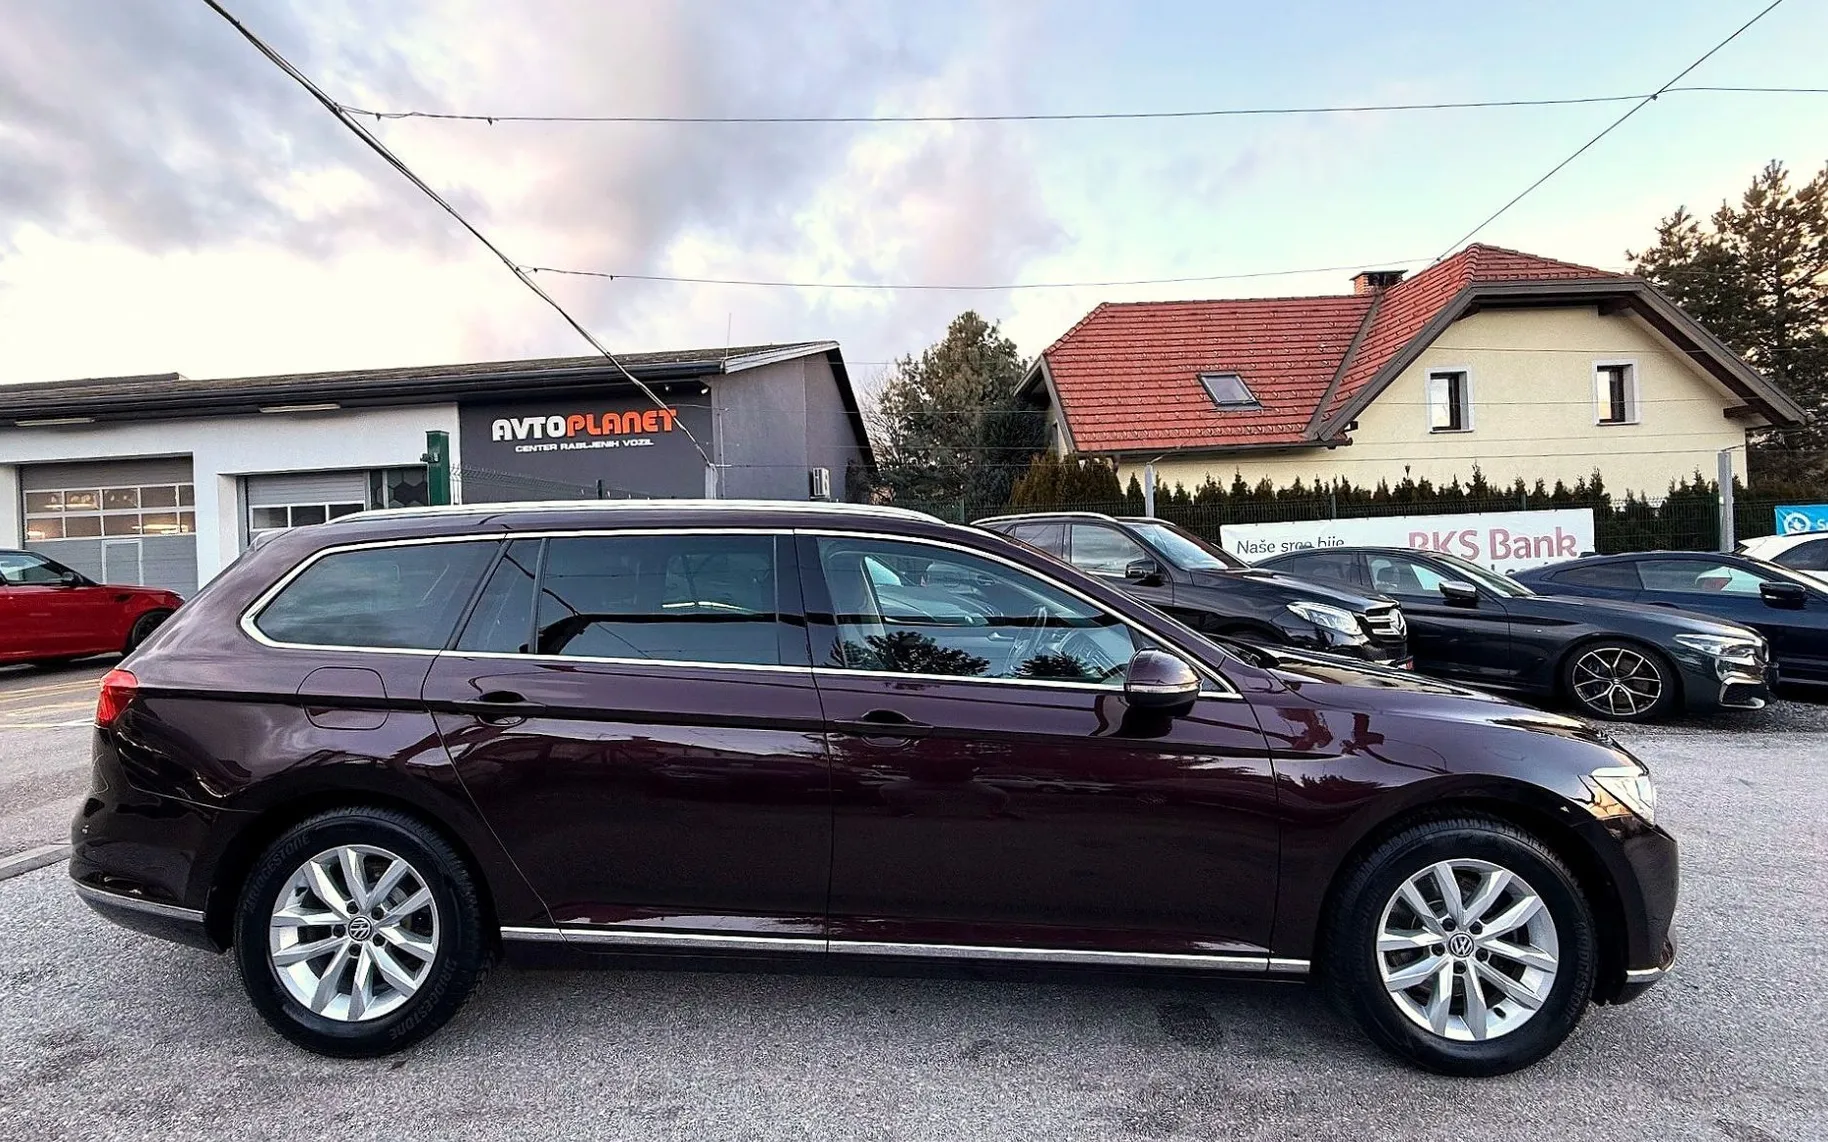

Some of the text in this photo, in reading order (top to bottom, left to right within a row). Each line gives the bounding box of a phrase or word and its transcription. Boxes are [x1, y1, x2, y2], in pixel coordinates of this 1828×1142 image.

[492, 409, 677, 442] AVTOPLANET
[515, 438, 654, 453] CENTER RABLJENIH VOZIL
[1236, 539, 1276, 554] Naše
[1489, 526, 1578, 561] Bank
